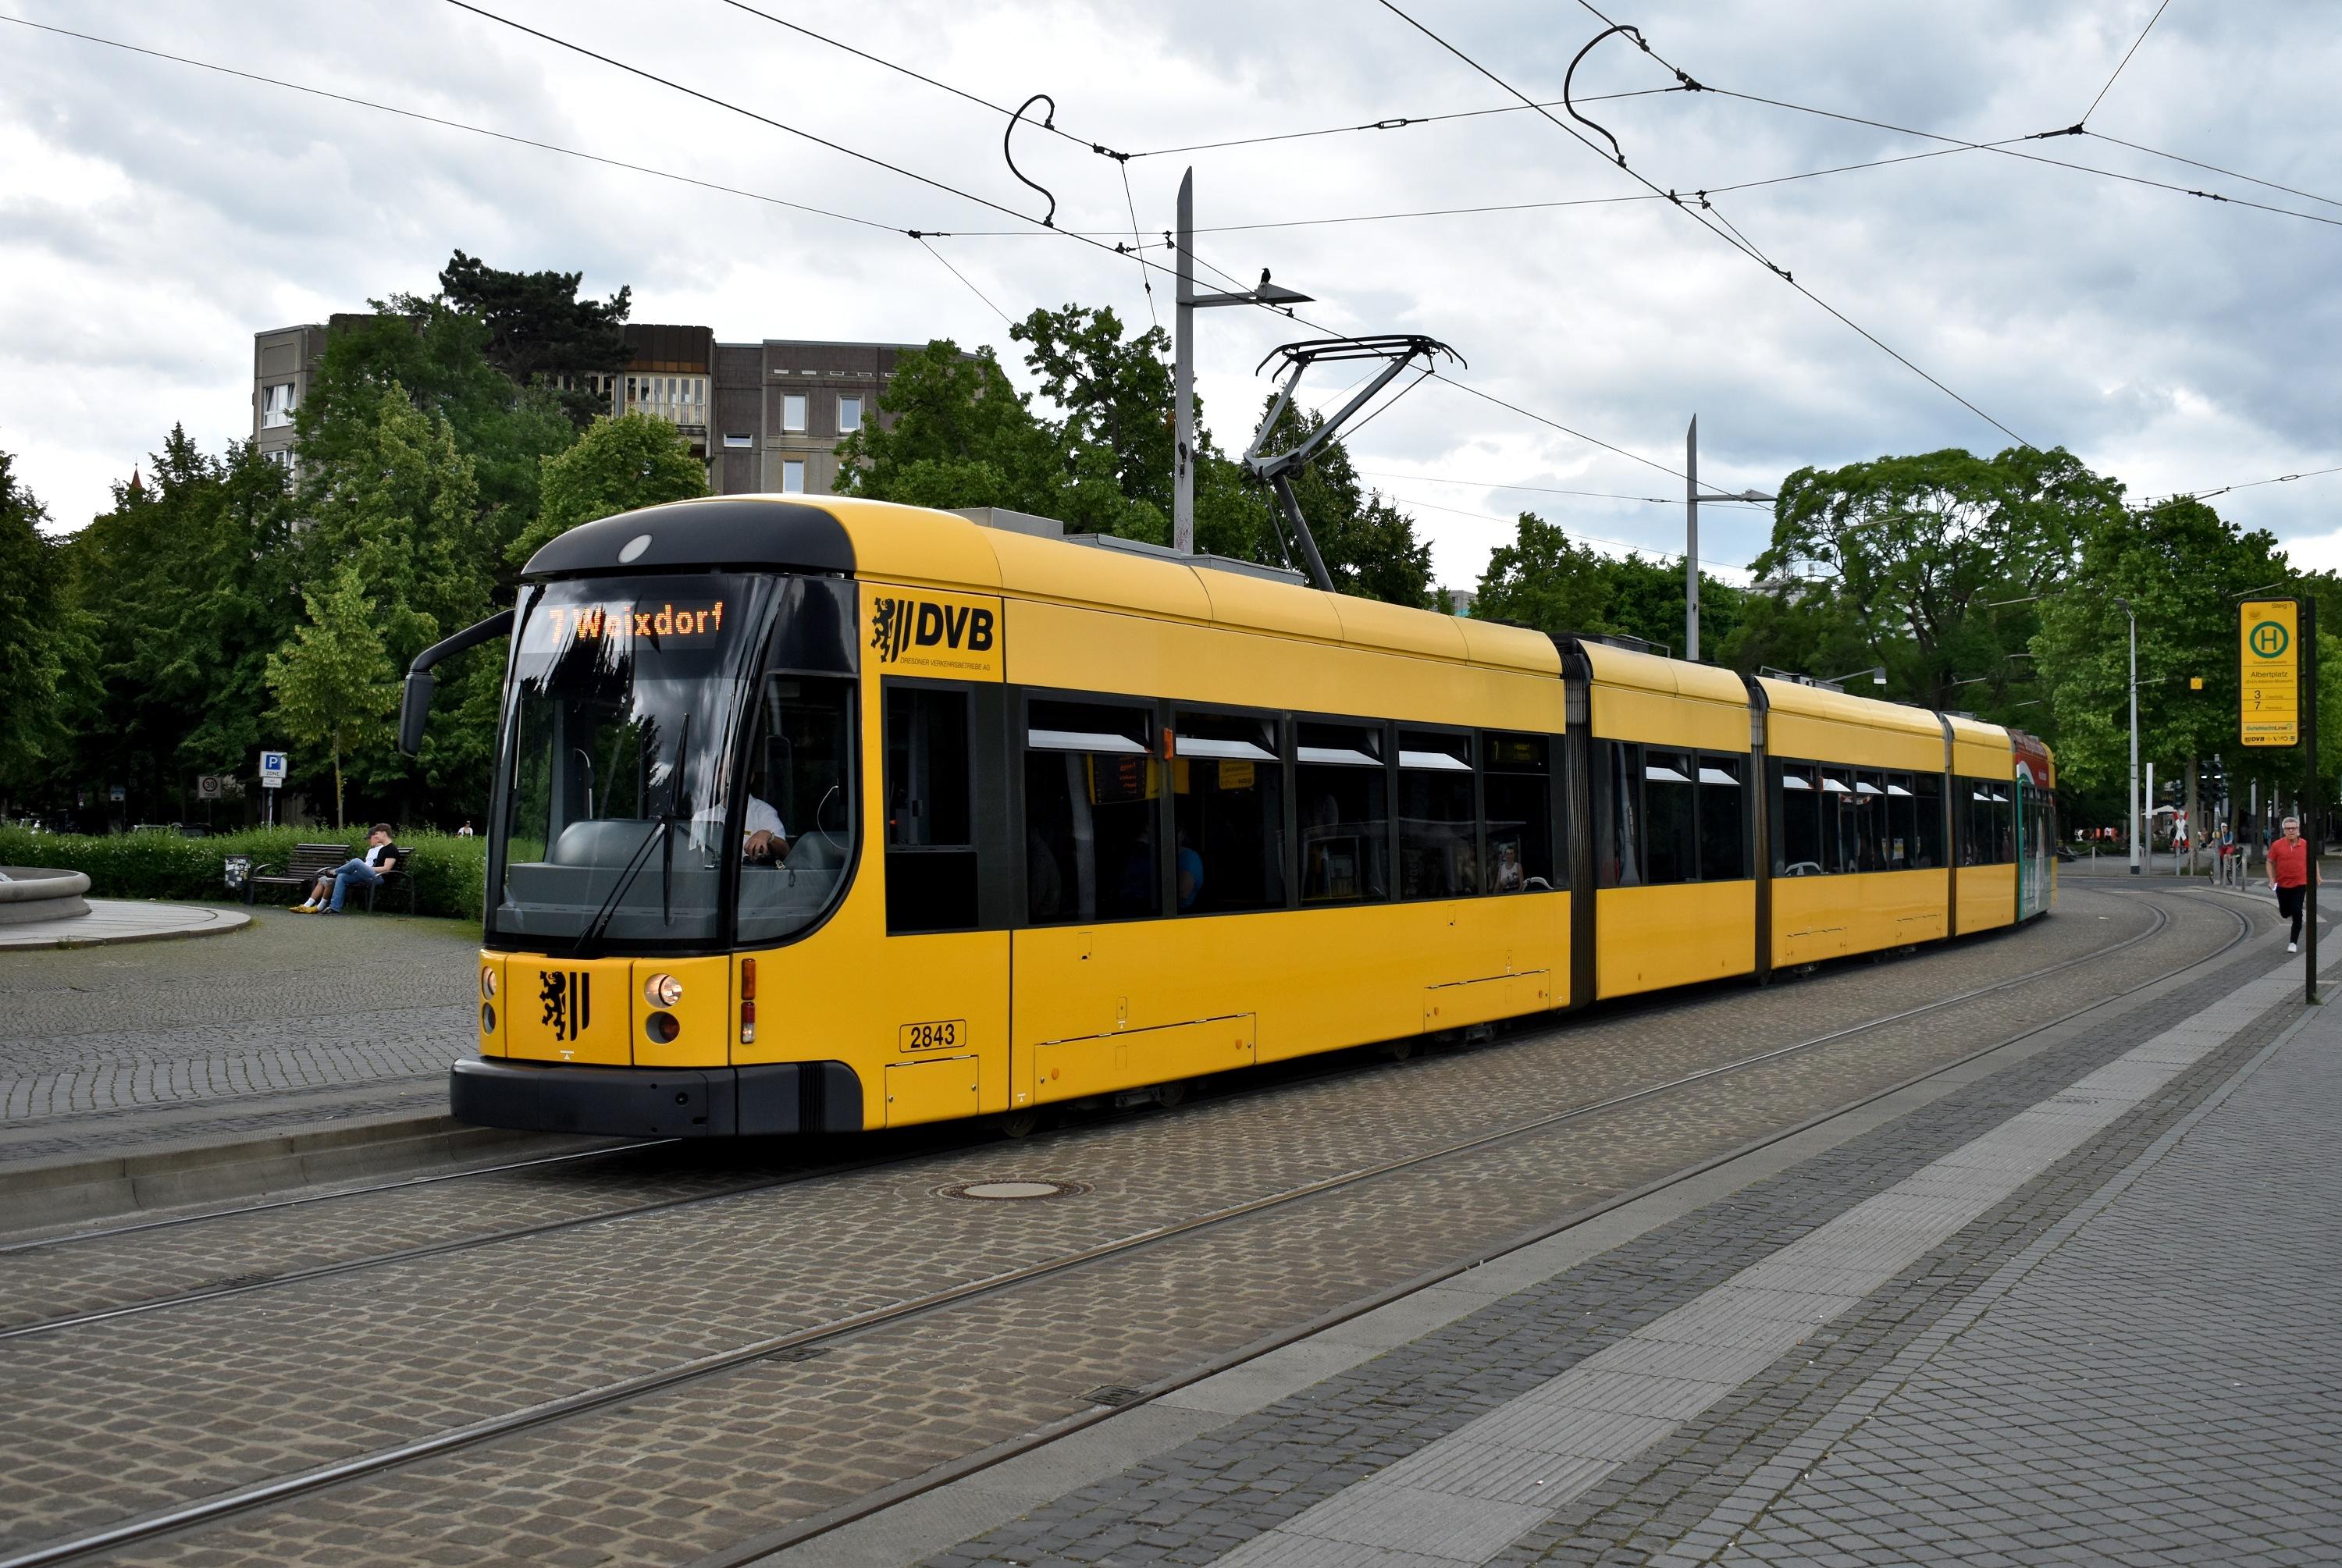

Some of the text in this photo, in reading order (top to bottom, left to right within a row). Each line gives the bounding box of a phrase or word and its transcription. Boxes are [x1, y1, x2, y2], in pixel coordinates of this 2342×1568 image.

[549, 601, 724, 644] 7 Weixdorf
[915, 602, 994, 652] DVB
[900, 656, 930, 666] DRESDNER
[931, 659, 982, 670] VERKEHRSBETRIEBE
[2251, 670, 2289, 679] Albertplatz
[2254, 690, 2262, 699] 3
[2254, 701, 2262, 709] 7
[910, 1023, 956, 1049] 2843
